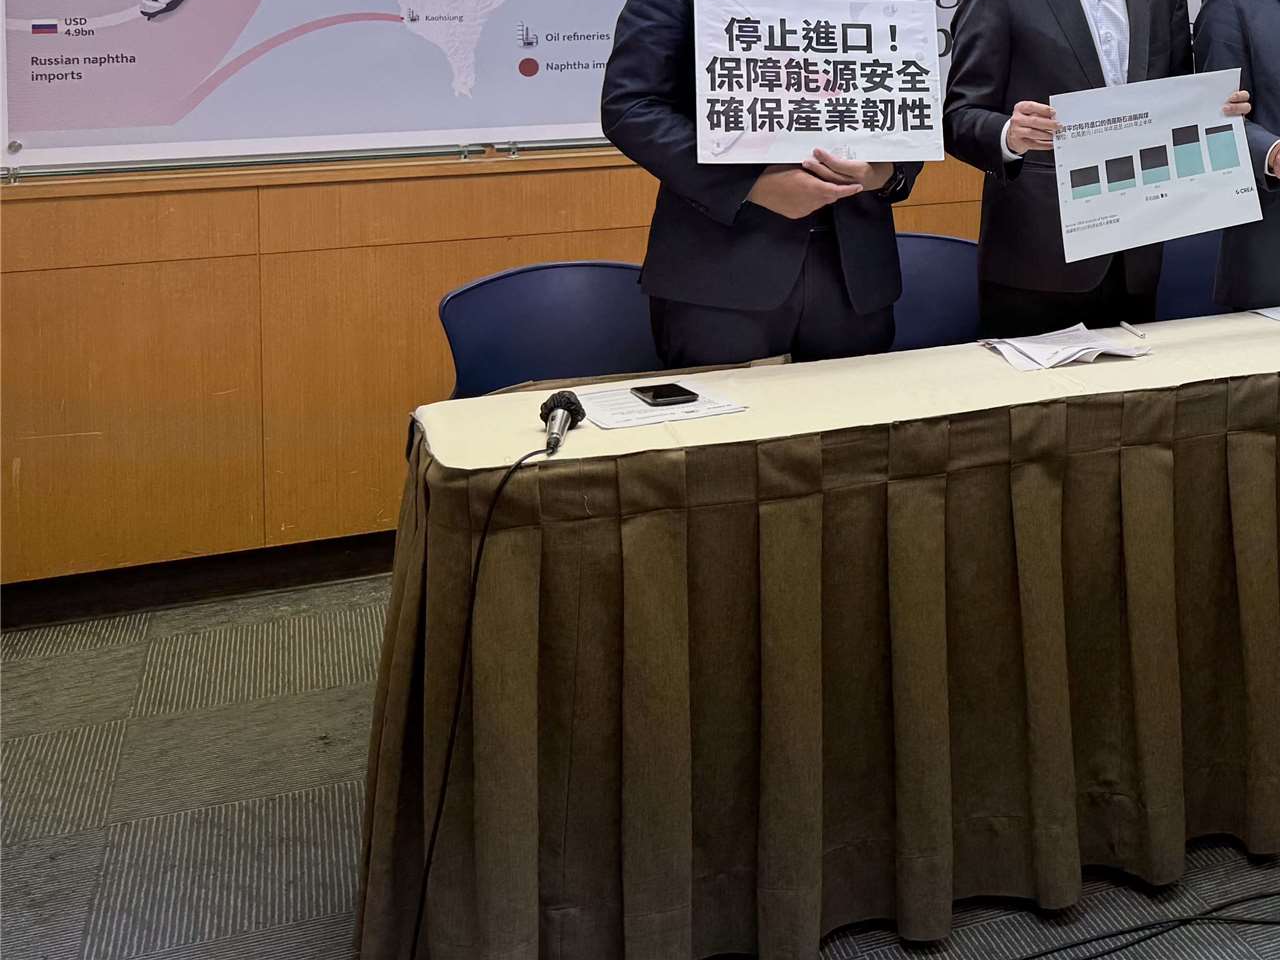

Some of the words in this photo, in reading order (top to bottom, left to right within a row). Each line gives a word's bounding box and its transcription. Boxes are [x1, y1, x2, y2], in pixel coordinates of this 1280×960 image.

[64, 17, 88, 27] USD
[425, 14, 464, 22] Kaohsiung
[64, 27, 95, 37] 4.9bn
[545, 32, 560, 42] Oil
[562, 32, 611, 42] refineries
[724, 17, 898, 54] 停止進口！
[31, 54, 80, 66] Russian
[83, 53, 136, 67] naphtha
[545, 60, 589, 72] Naphtha
[31, 70, 83, 83] imports
[705, 56, 931, 93] 保障能源安全
[706, 97, 934, 132] 確保產業韌性
